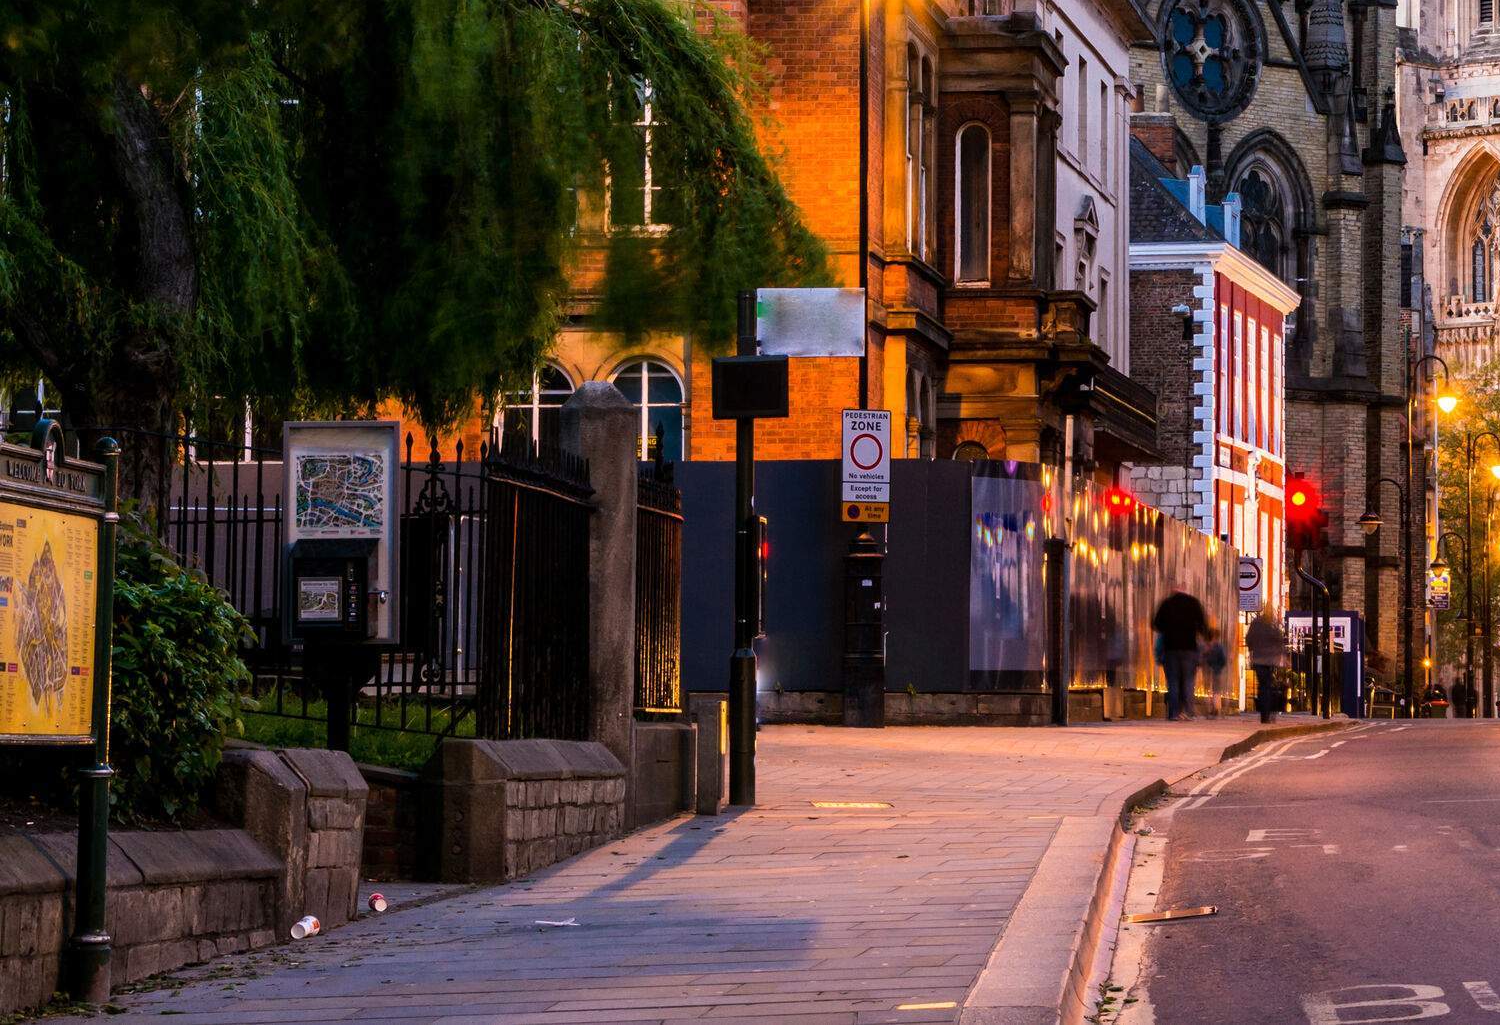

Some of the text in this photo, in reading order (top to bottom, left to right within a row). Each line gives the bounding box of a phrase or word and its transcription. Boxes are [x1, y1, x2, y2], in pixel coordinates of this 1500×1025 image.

[845, 412, 888, 420] PEDESTRIAN
[851, 421, 882, 431] ZONE
[8, 459, 87, 492] WELCOME TO YORK
